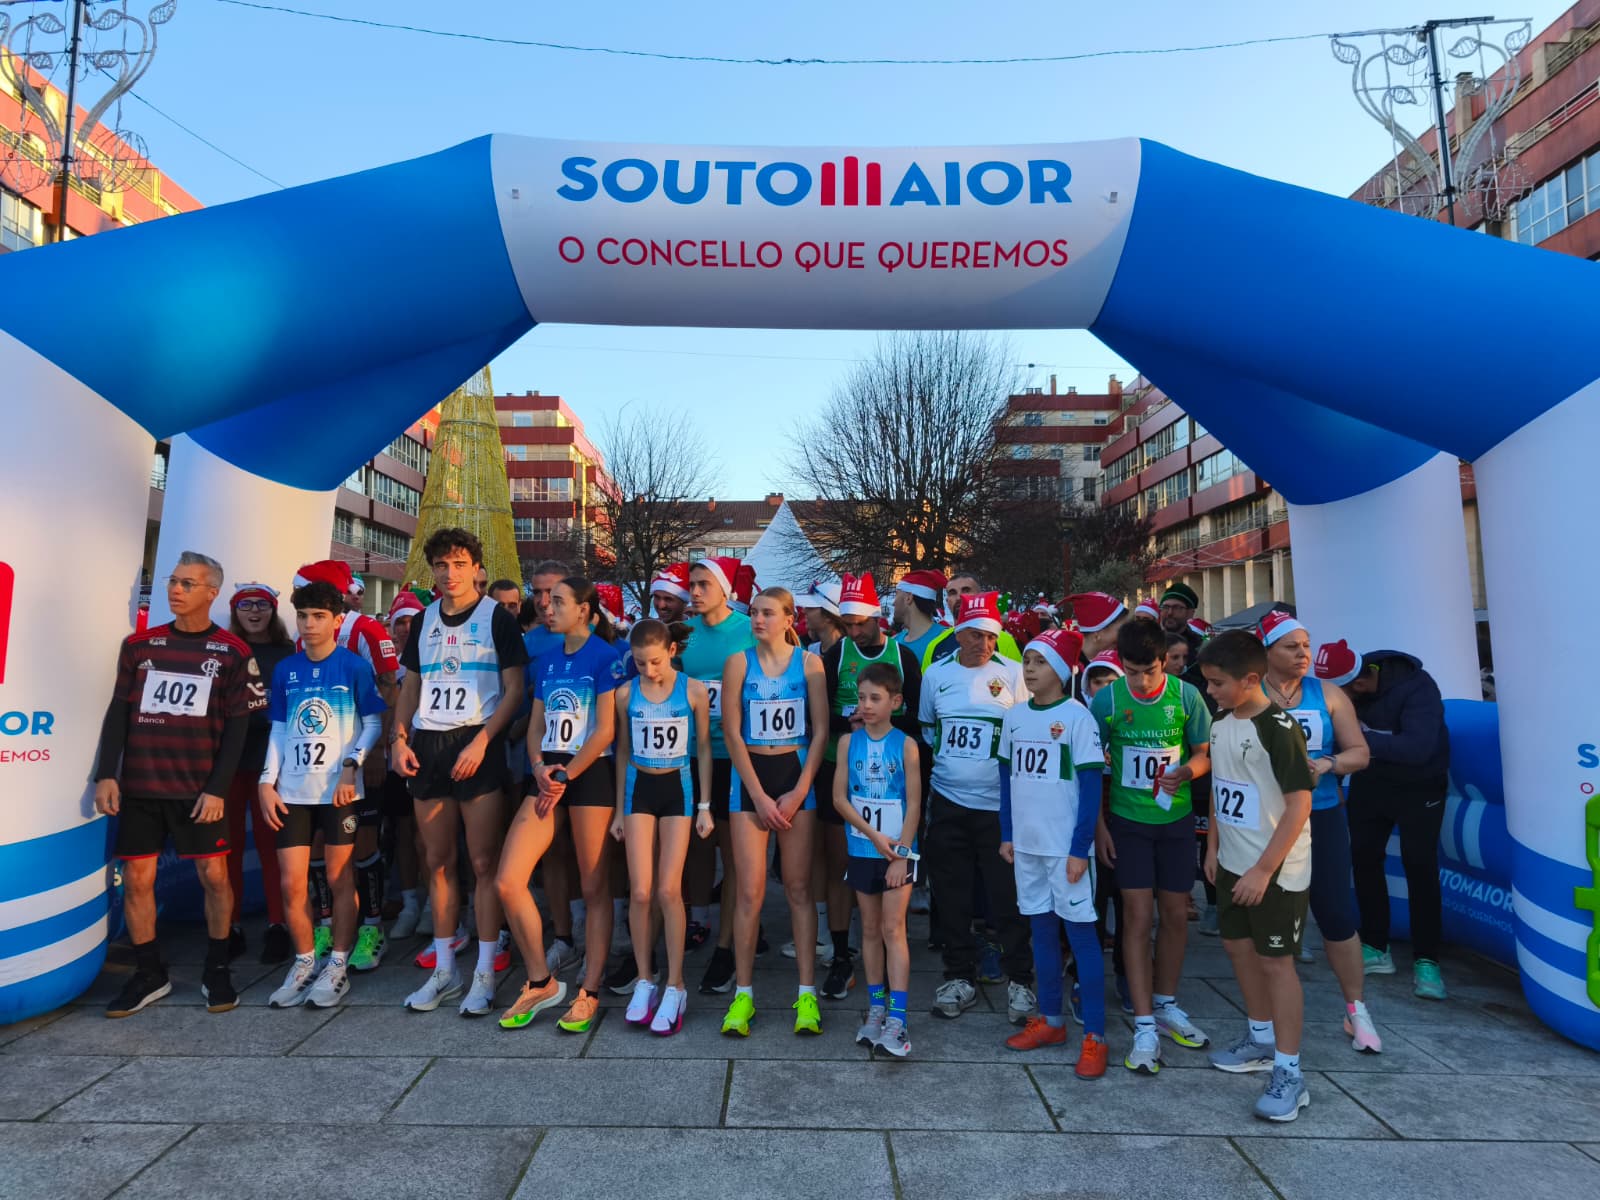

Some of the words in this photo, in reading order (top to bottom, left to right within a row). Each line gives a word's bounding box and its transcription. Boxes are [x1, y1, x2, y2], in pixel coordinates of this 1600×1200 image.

[558, 236, 585, 264] O
[596, 237, 783, 269] CONCELLO
[795, 241, 865, 273] QUE
[878, 239, 1068, 273] QUEREMOS
[153, 681, 198, 707] 402
[430, 687, 466, 710] 212
[138, 716, 165, 724] Banco
[759, 707, 795, 732] 160
[641, 725, 678, 750] 159
[947, 726, 982, 749] 483
[294, 743, 326, 765] 132
[1016, 747, 1048, 774] 102
